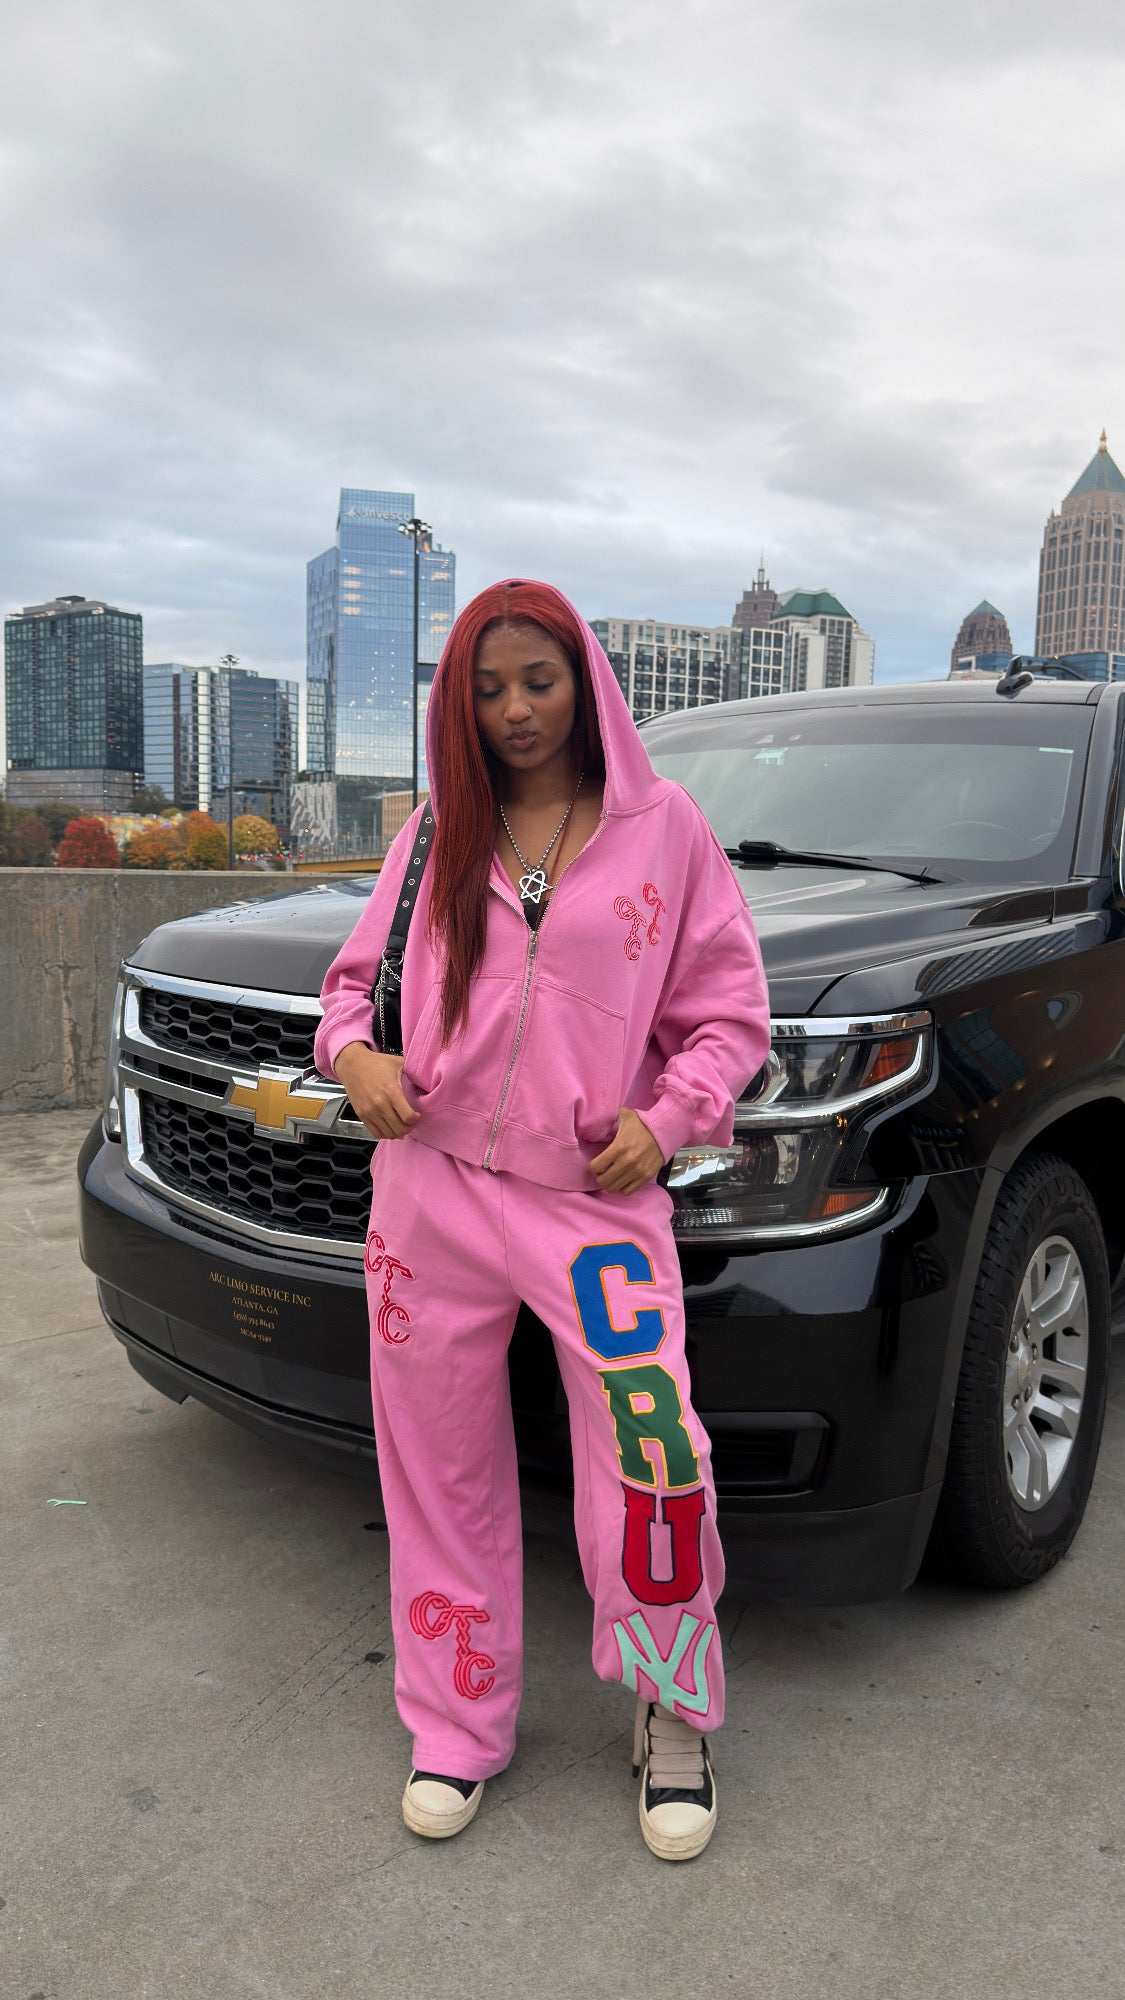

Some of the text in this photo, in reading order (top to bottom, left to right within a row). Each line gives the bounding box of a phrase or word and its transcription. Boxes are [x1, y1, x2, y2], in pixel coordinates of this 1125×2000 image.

[209, 1271, 226, 1284] ARC
[227, 1277, 248, 1292] LIMO
[250, 1283, 290, 1303] SERVICE
[266, 1305, 279, 1316] GA
